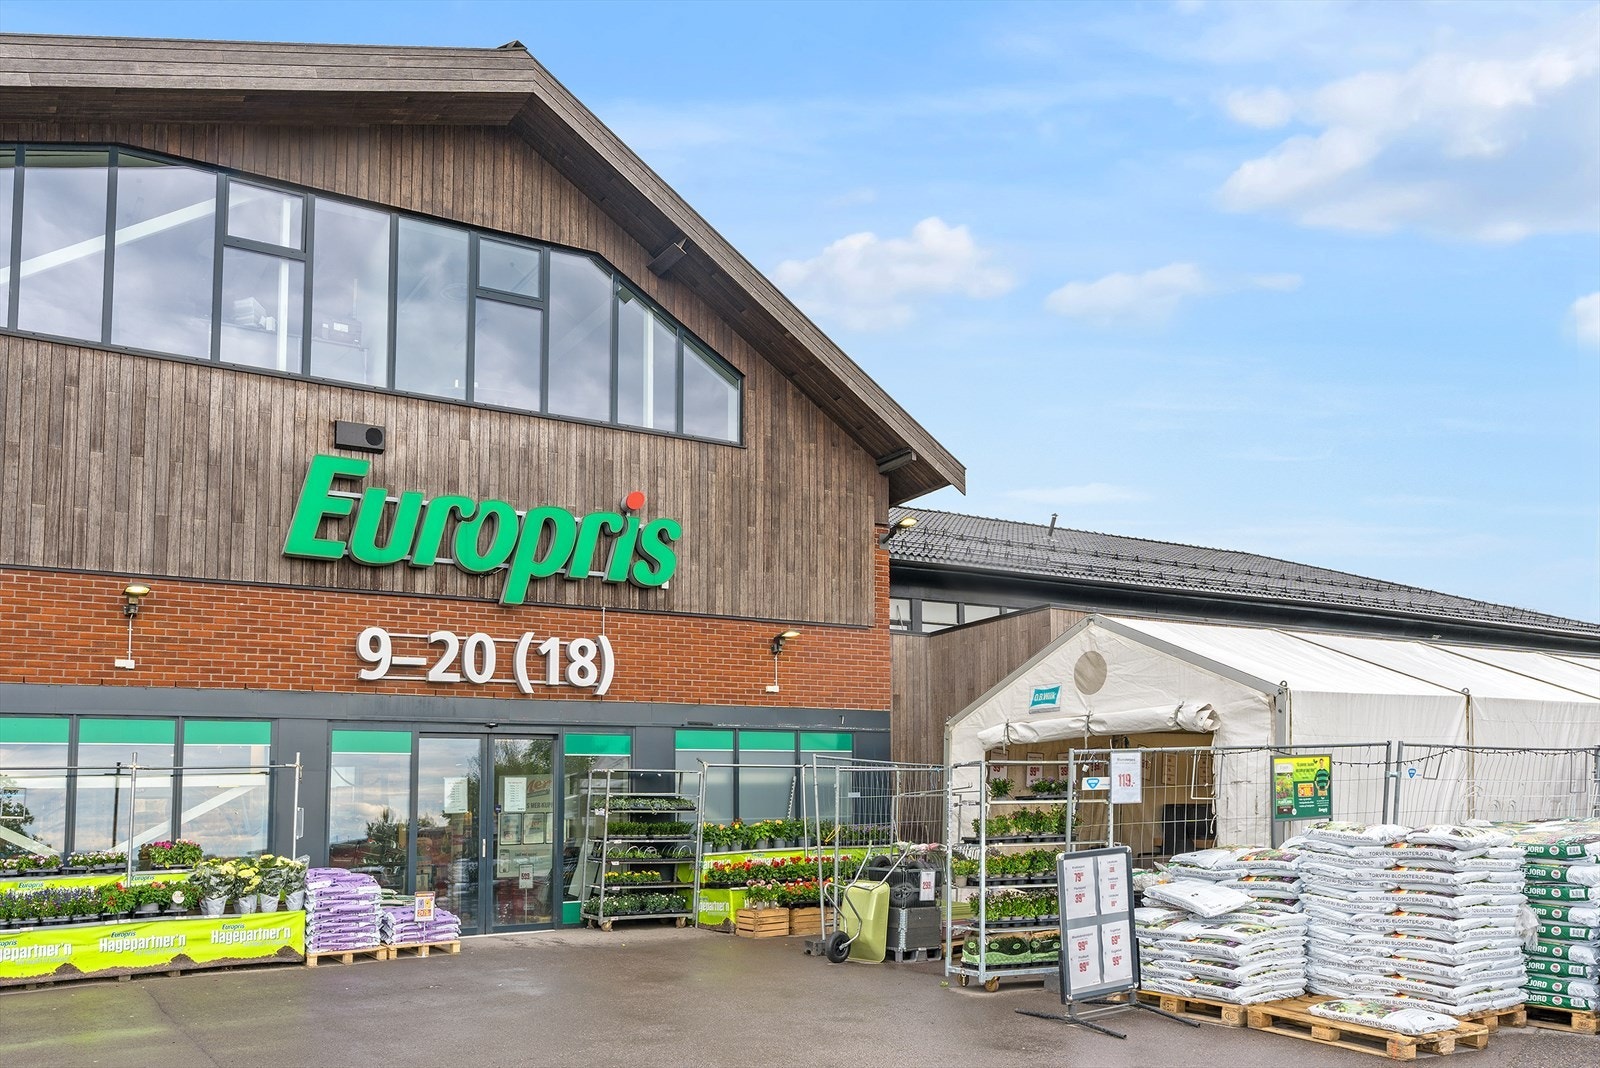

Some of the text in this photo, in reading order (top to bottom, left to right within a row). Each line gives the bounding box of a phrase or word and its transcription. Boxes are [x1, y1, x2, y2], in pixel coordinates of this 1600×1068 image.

[282, 454, 682, 605] Europris
[513, 632, 615, 695] (18)
[100, 934, 186, 953] Hagepartner'n
[211, 927, 291, 944] Hagepartner'n
[1391, 941, 1433, 949] BLOMSTERJORD
[1390, 982, 1433, 992] BLOMSTERJORD
[1354, 1018, 1397, 1030] BLOMSTERJORD
